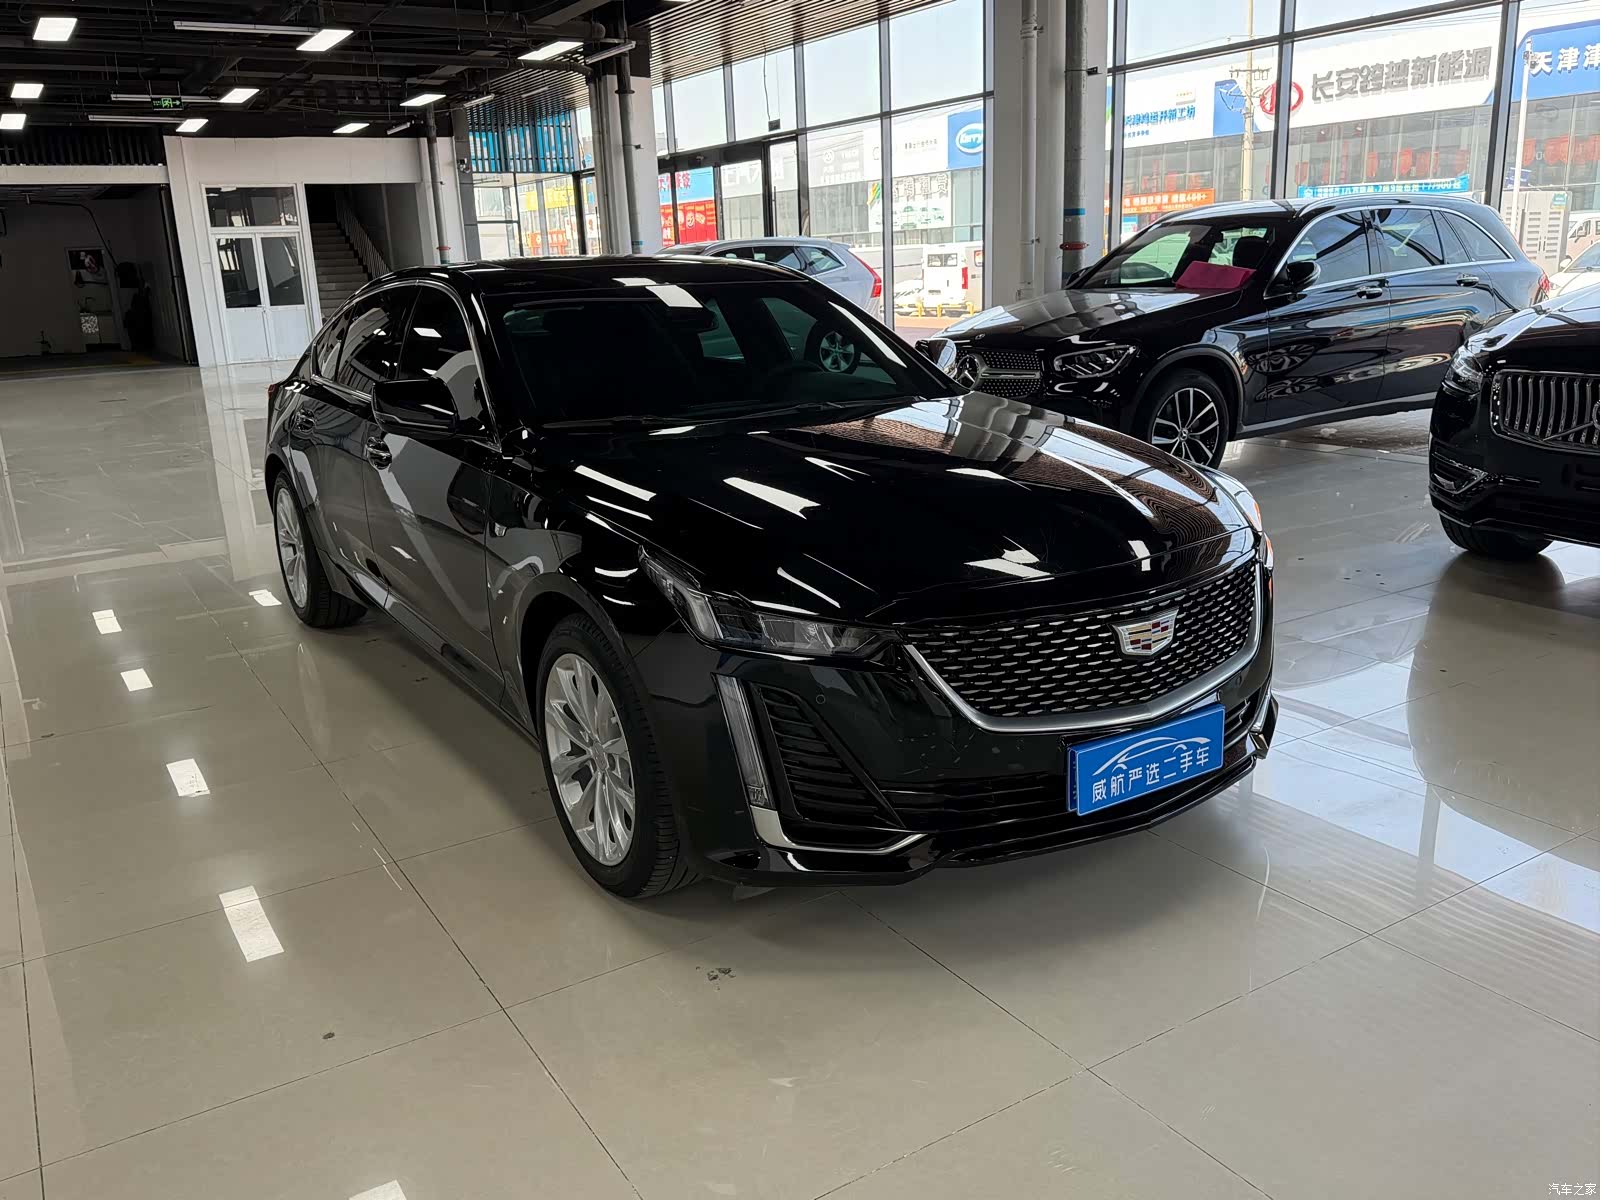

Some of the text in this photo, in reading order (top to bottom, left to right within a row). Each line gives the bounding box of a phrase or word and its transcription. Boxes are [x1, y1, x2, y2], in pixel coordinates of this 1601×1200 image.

[1312, 46, 1492, 103] 长安跨越新能源
[1091, 746, 1210, 804] 威航严选二手车
